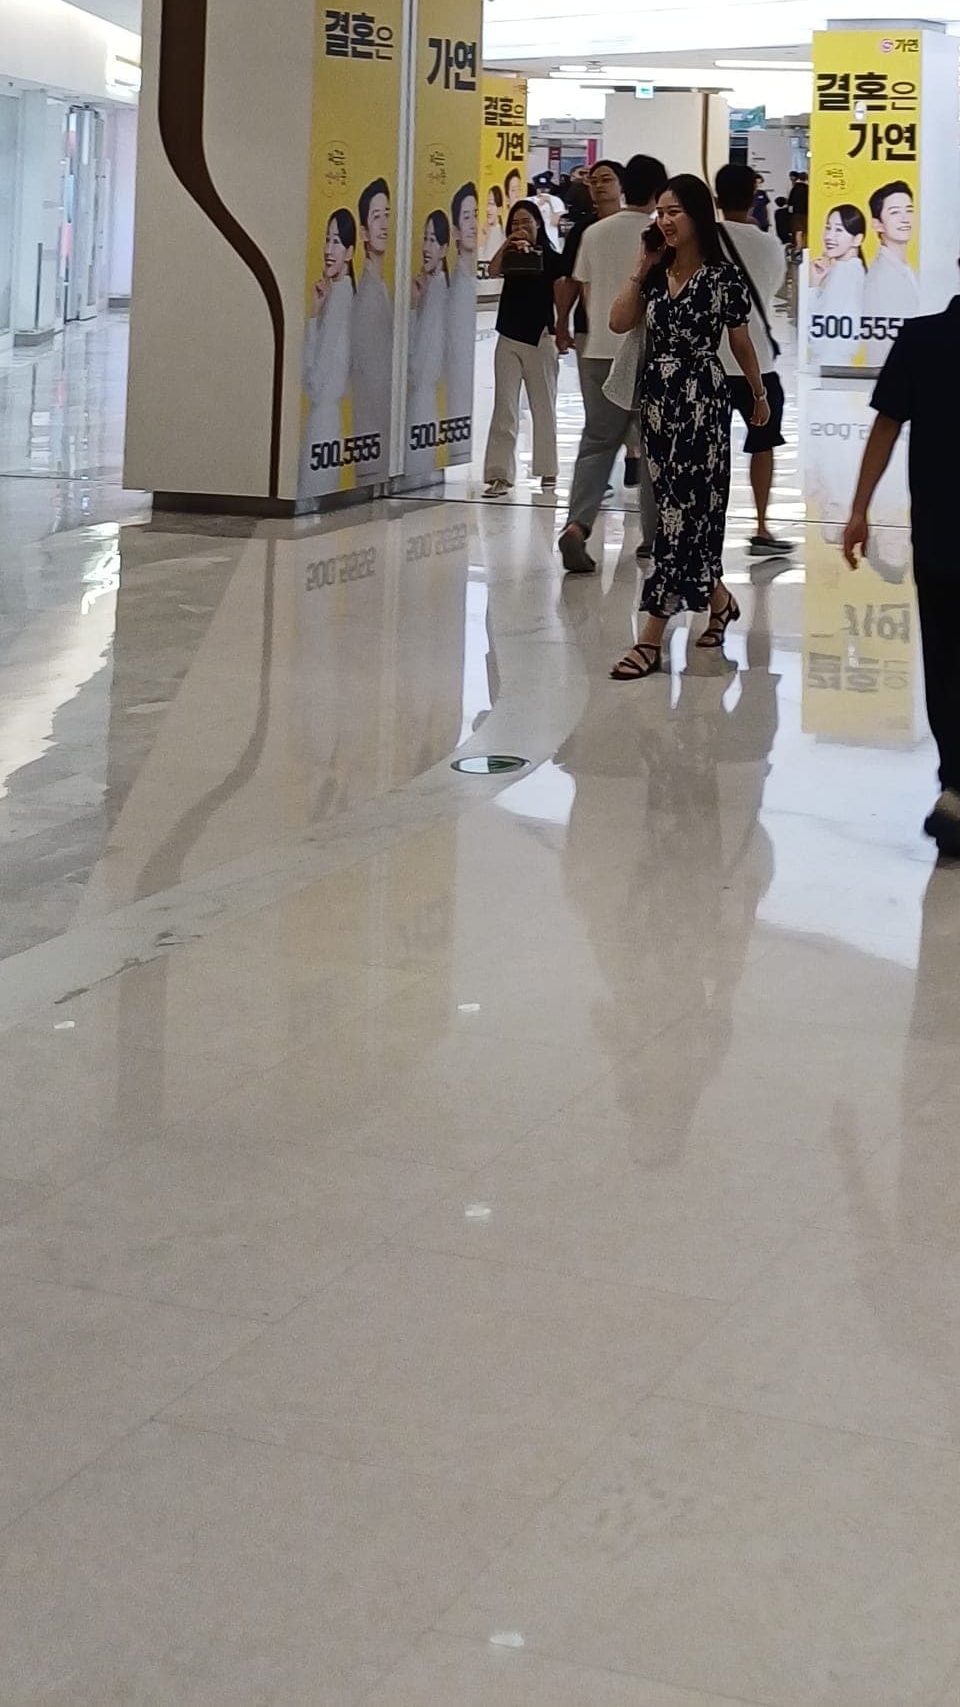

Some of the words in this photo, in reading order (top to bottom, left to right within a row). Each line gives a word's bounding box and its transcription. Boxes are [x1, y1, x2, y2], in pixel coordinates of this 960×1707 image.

[324, 9, 394, 61] 결혼은
[426, 37, 478, 92] 가연
[893, 38, 920, 53] 가연
[815, 71, 919, 112] 결혼은
[484, 95, 525, 127] 결혼은
[495, 131, 526, 162] 가연
[847, 122, 918, 162] 가연
[810, 314, 902, 341] 500.555
[409, 416, 473, 451] 500.5555
[310, 432, 382, 471] 500.5555
